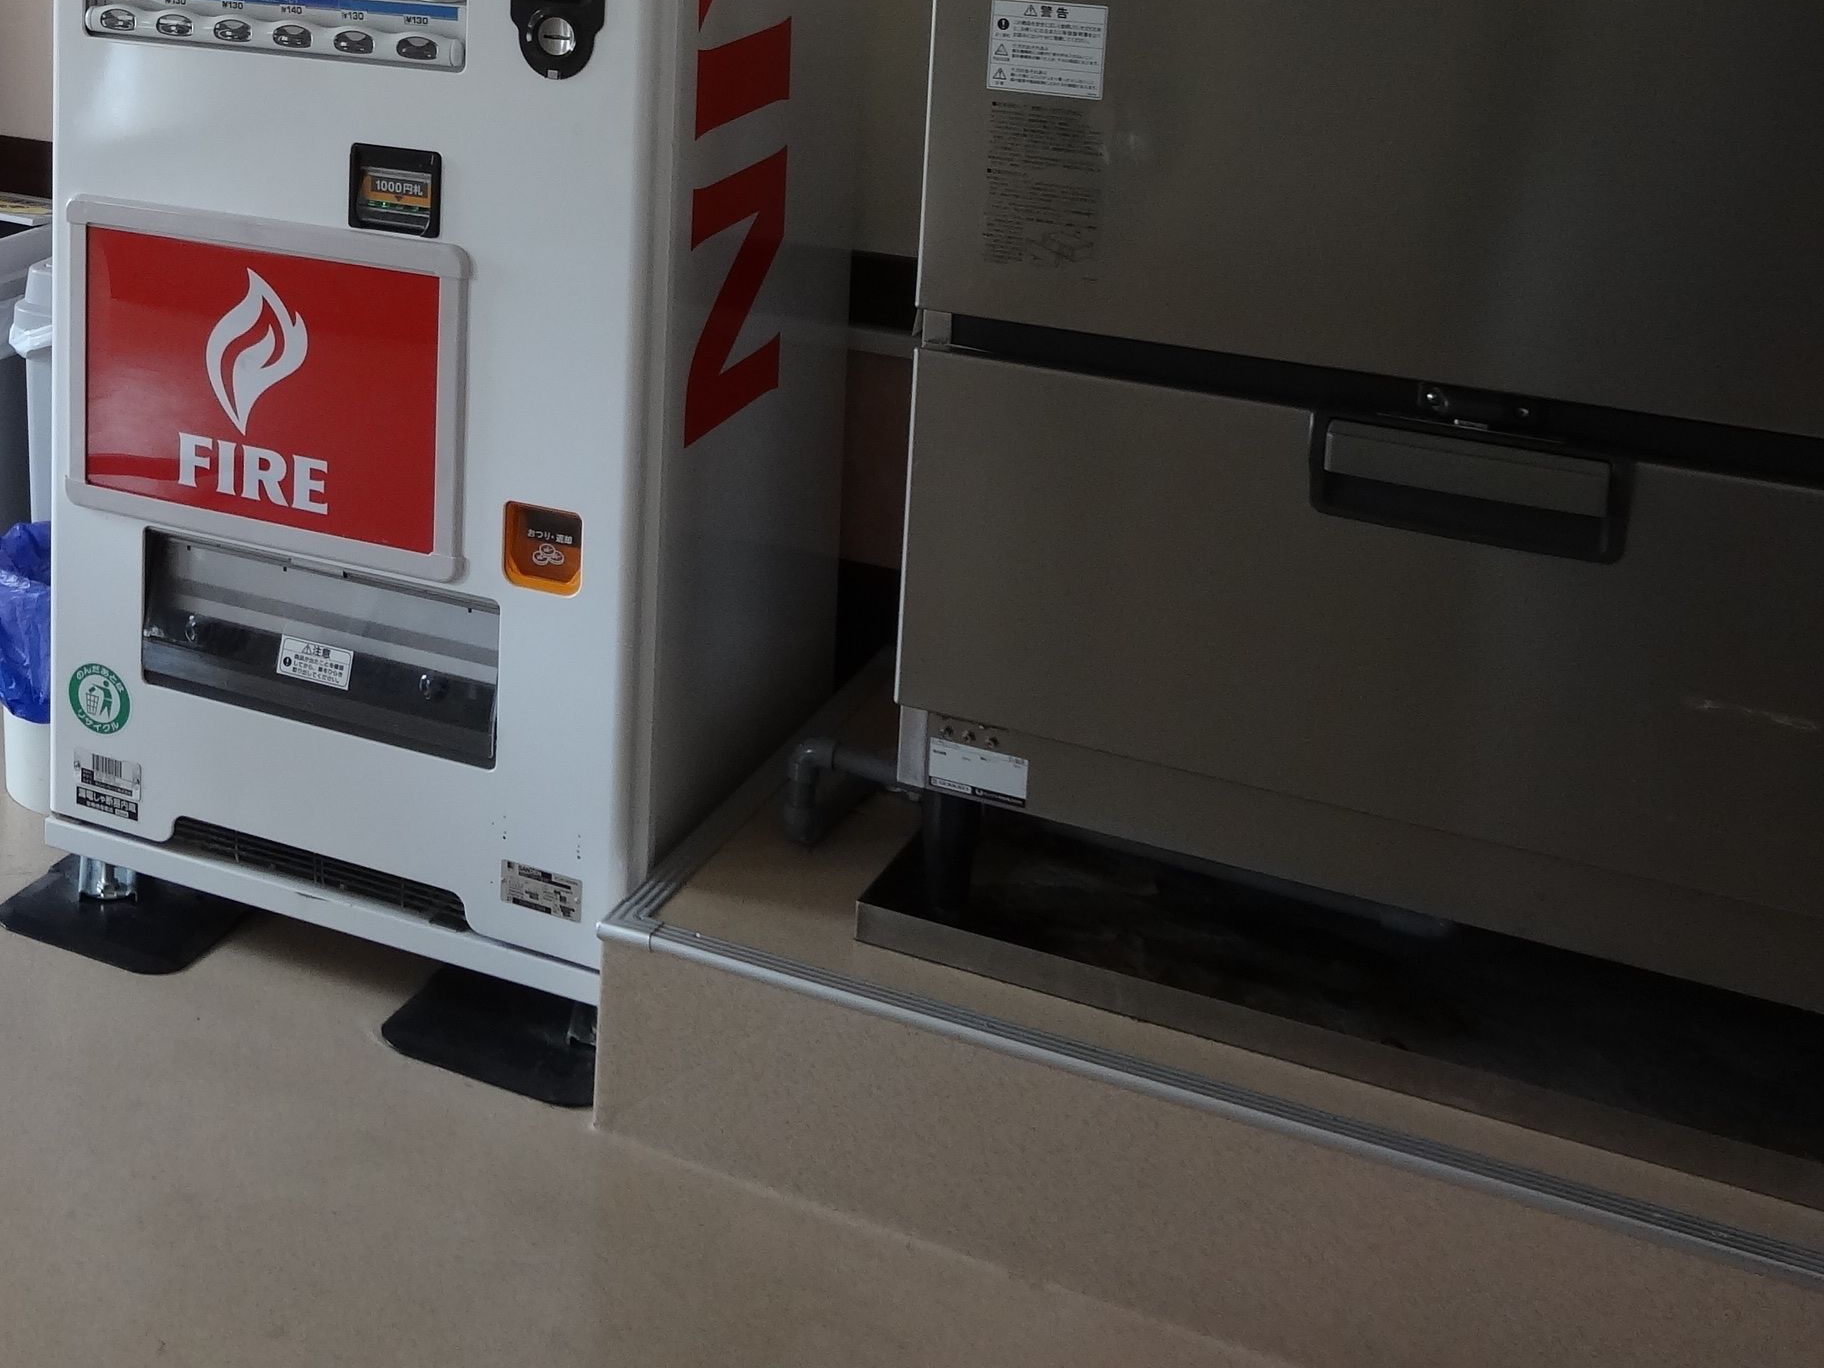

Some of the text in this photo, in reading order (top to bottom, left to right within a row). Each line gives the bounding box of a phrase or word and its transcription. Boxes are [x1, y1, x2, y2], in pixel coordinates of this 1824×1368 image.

[1040, 5, 1069, 19] 警告
[406, 16, 429, 25] ¥130
[375, 180, 423, 196] 1000円札
[177, 432, 328, 515] FIRE
[77, 708, 120, 732] リサイクル
